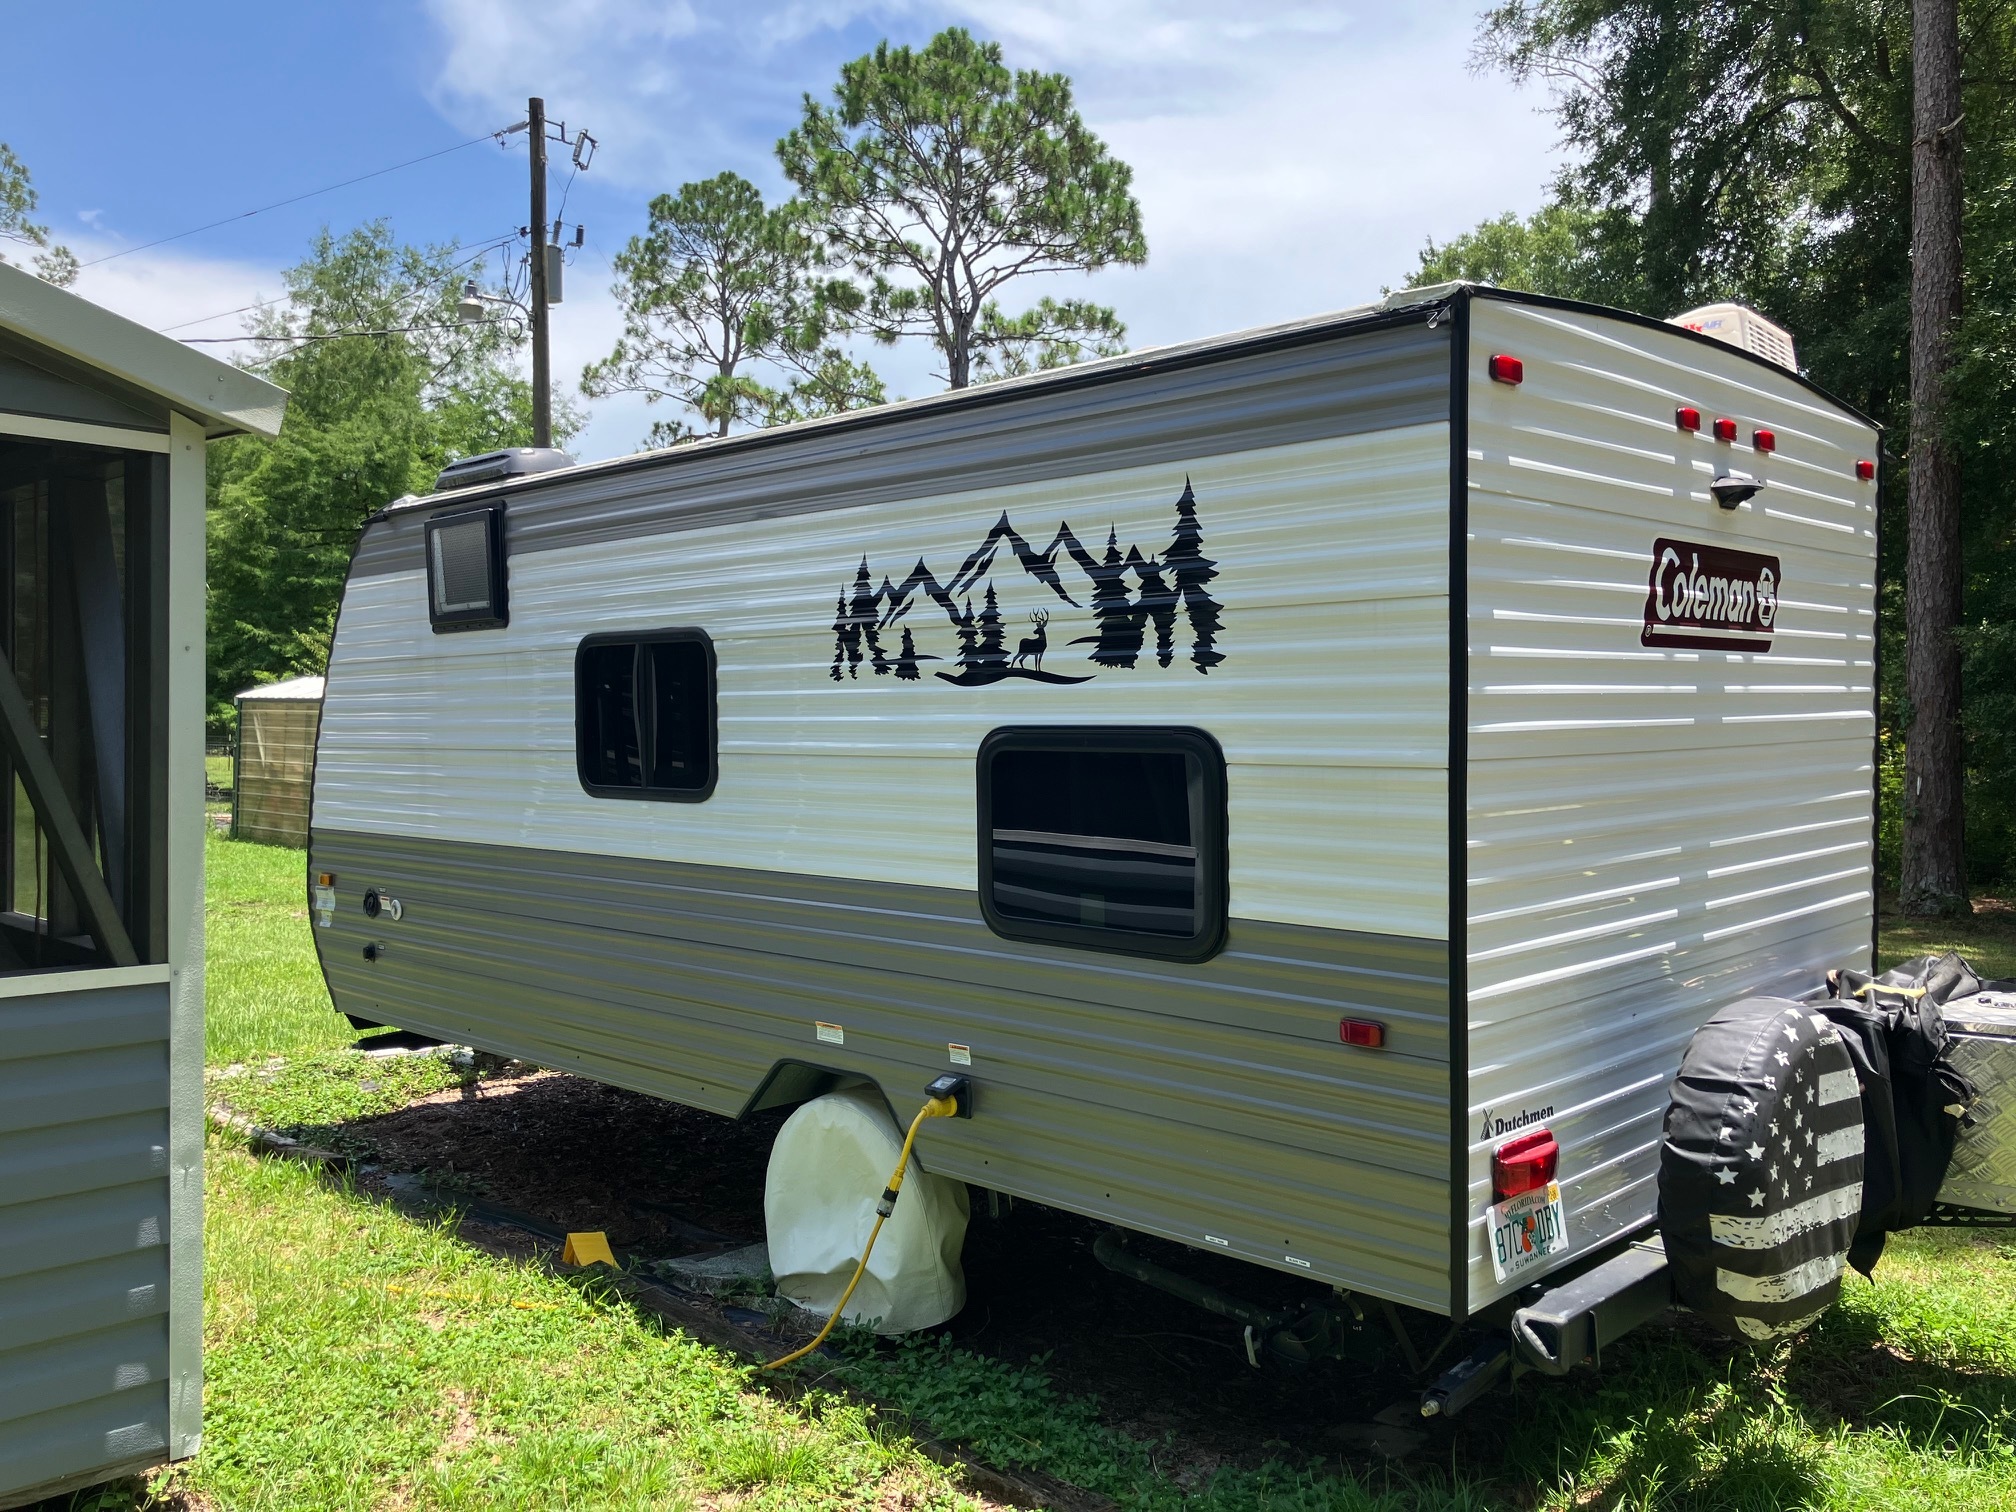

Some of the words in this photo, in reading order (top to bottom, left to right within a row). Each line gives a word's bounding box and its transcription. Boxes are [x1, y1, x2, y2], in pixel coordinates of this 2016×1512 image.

[1655, 547, 1755, 623] Coleman
[1495, 1105, 1554, 1136] Dutchmen
[1535, 1202, 1561, 1244] DBY
[1515, 1245, 1551, 1270] SUWANNEE
